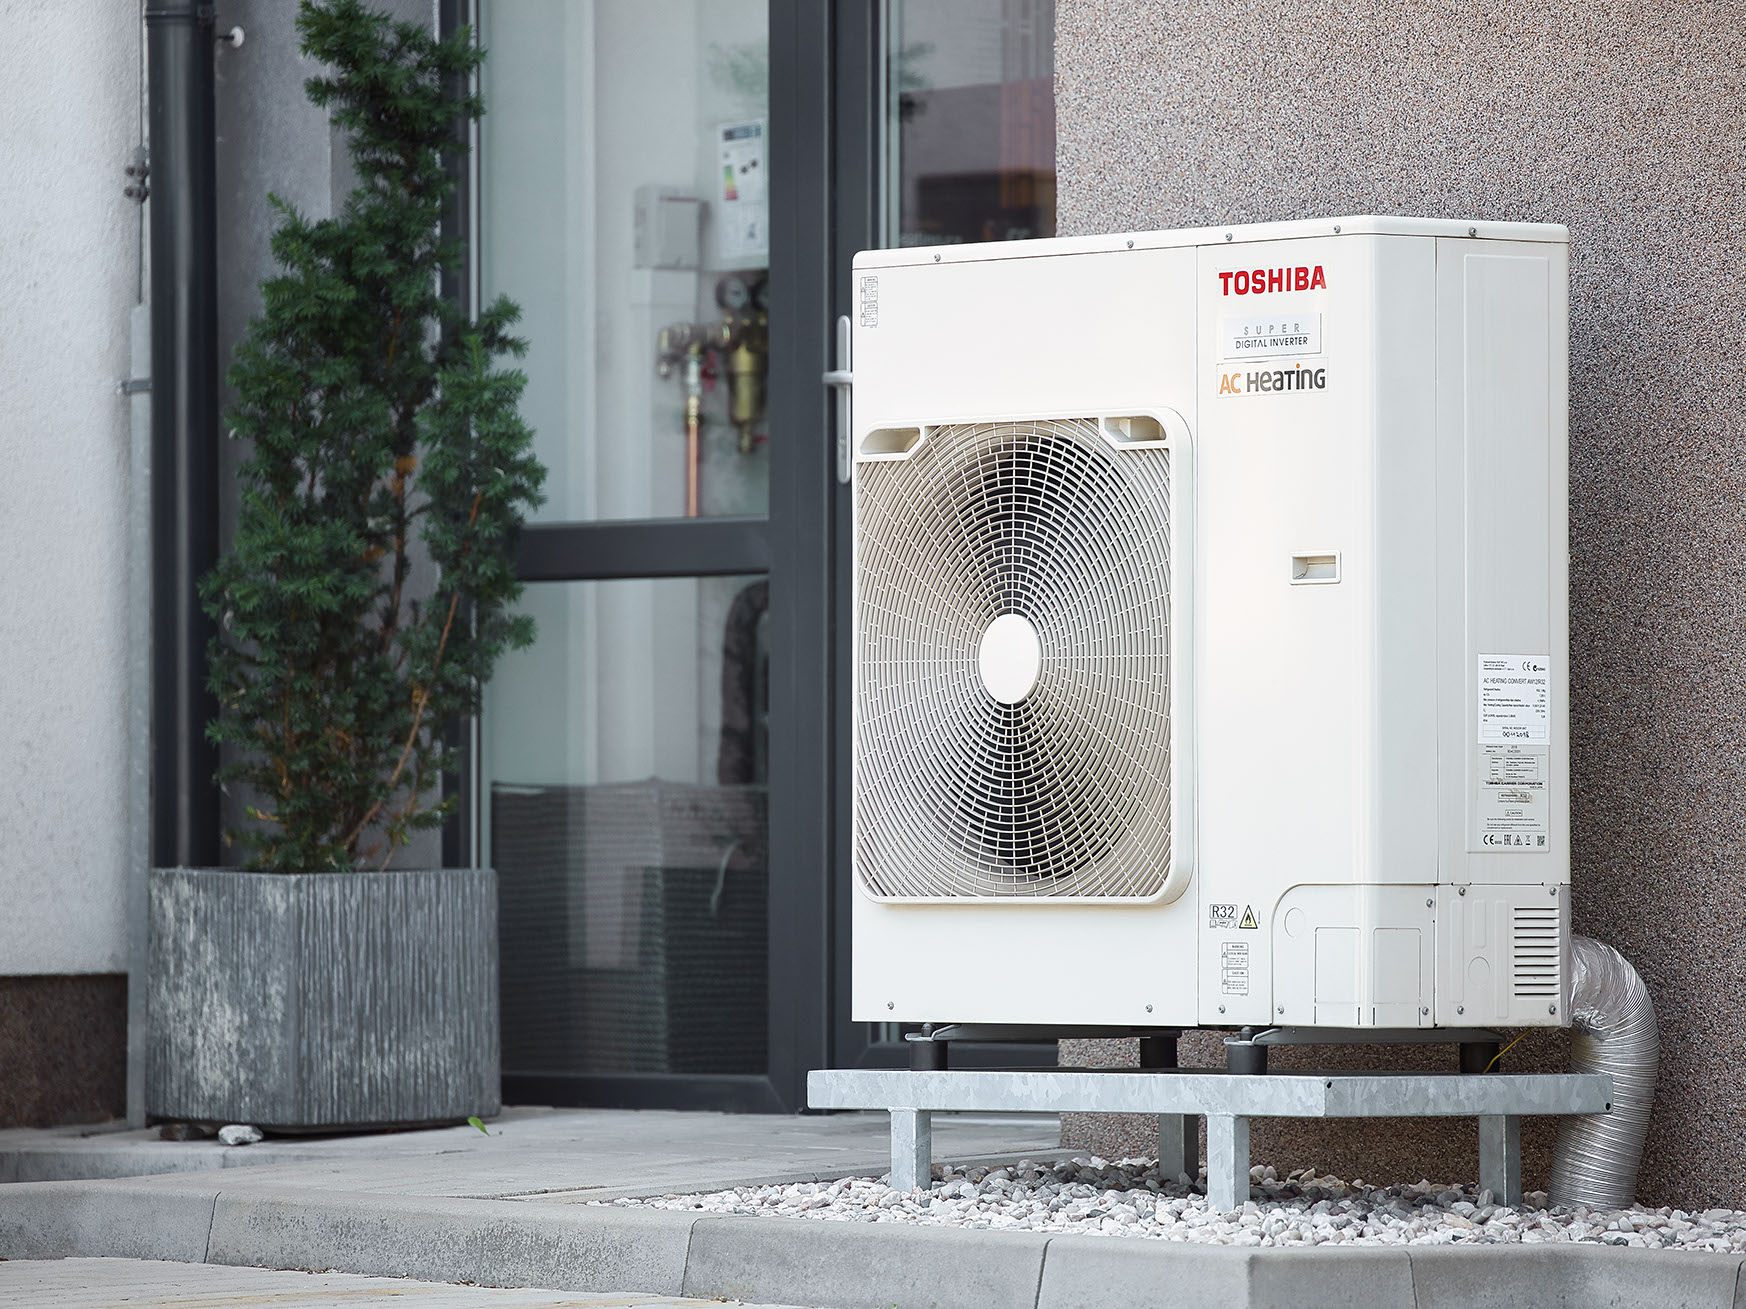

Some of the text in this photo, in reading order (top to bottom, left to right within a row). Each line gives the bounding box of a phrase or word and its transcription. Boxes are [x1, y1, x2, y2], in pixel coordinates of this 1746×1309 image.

[1218, 265, 1327, 296] TOSHIBA
[1243, 323, 1300, 336] SUPER
[1235, 336, 1308, 349] DIGITAL INVERTER
[1219, 373, 1242, 394] AC
[1490, 677, 1507, 685] HEATING
[1483, 834, 1495, 846] CE
[1212, 905, 1235, 919] R32
